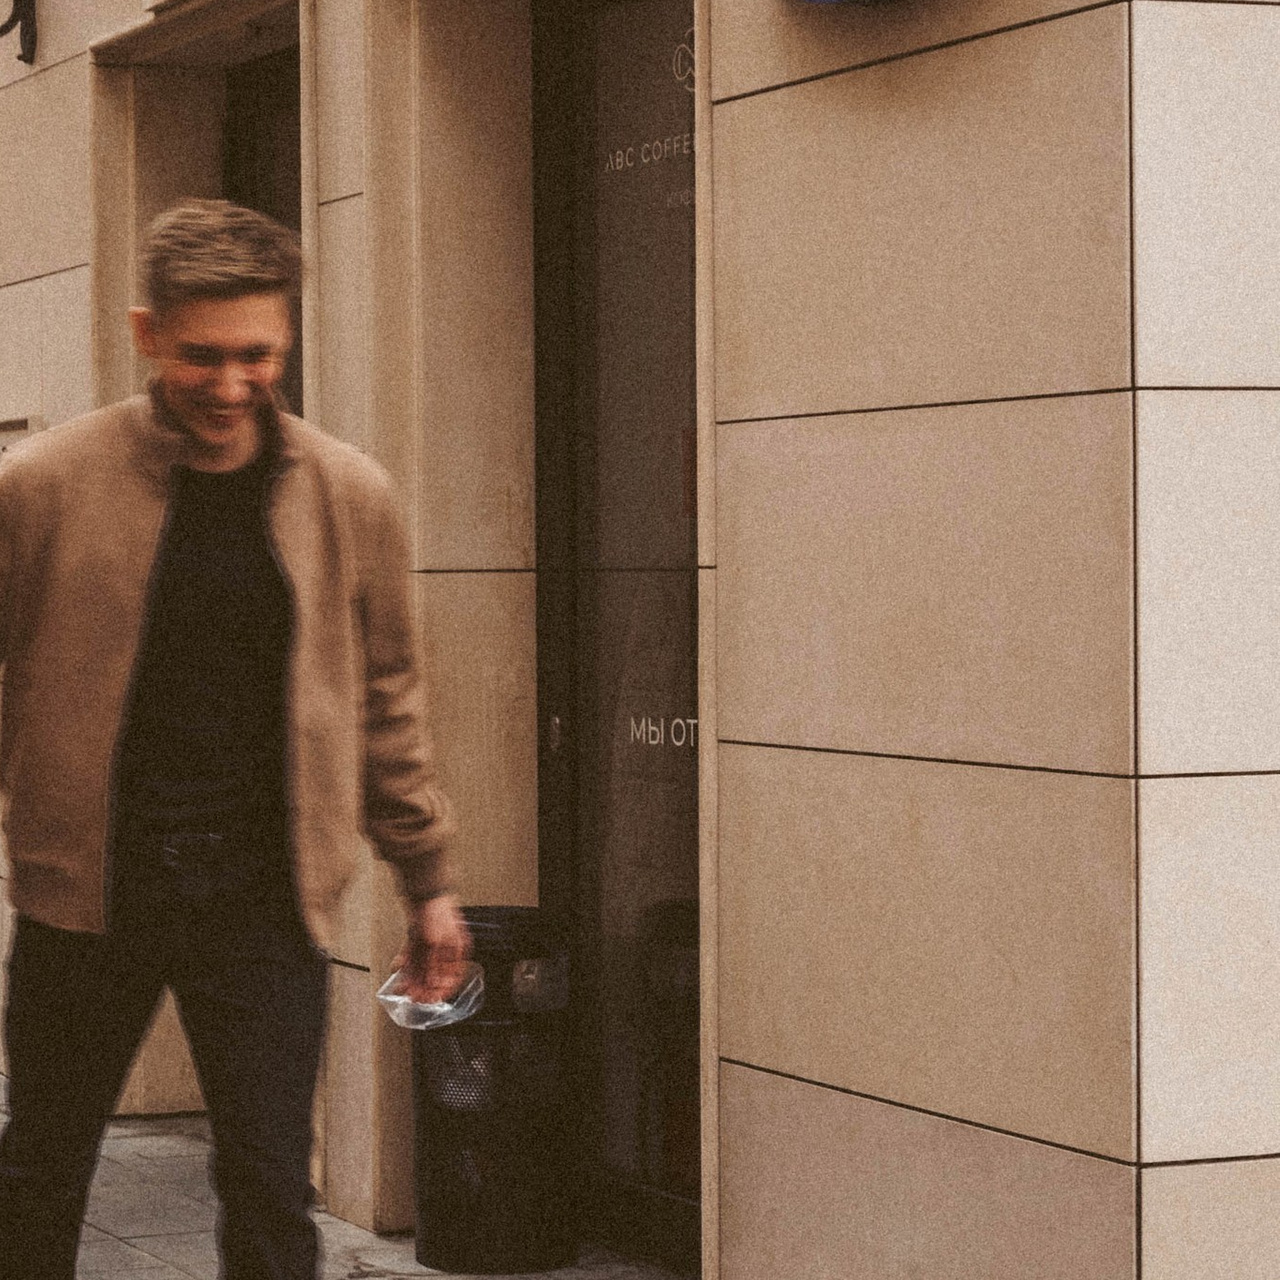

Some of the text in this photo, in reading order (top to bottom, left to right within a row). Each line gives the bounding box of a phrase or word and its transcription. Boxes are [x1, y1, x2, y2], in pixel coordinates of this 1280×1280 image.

[606, 132, 695, 171] ABC COFFE
[630, 717, 665, 745] МЫ
